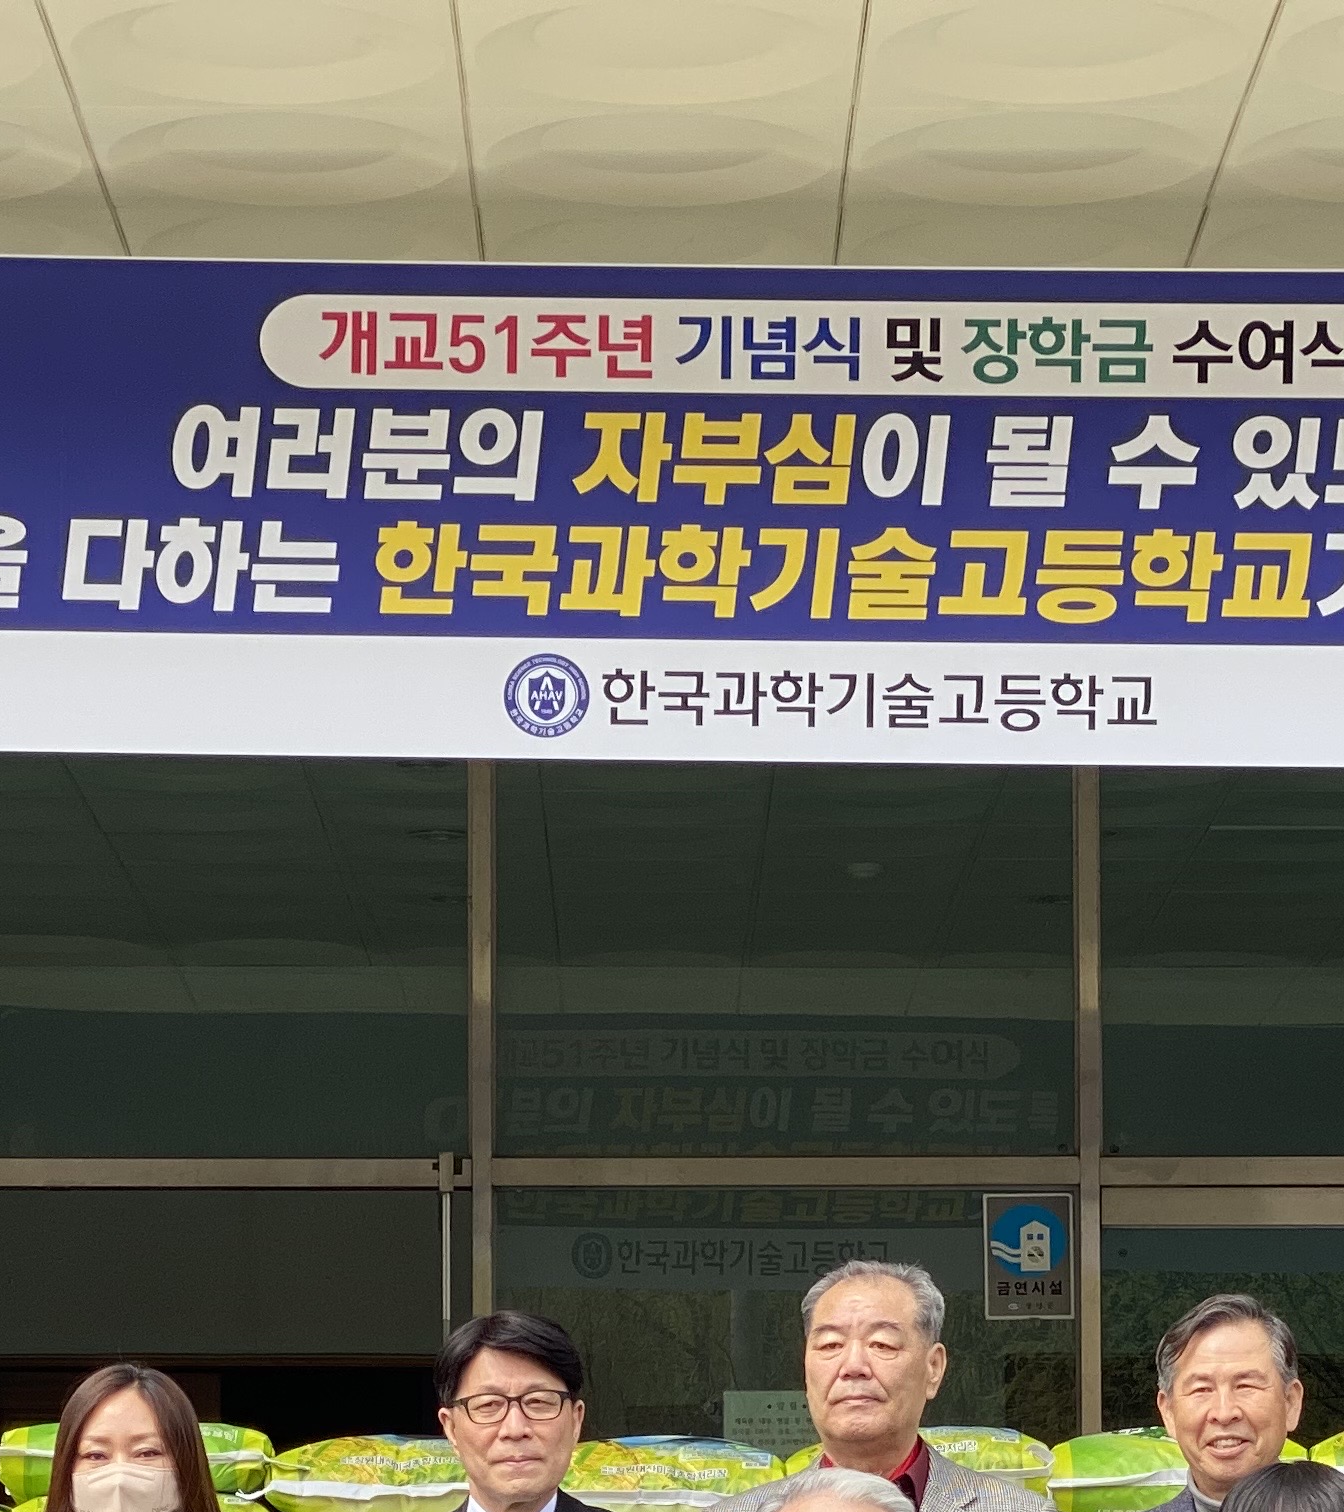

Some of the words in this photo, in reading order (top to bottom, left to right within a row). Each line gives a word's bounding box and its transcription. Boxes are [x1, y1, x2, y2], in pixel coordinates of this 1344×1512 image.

[319, 309, 653, 381] 개교51주년
[676, 315, 862, 383] 기념식
[885, 318, 941, 384] 및
[962, 317, 1153, 385] 장학금
[172, 403, 545, 501] 여러분의
[574, 411, 950, 507] 자부심이
[986, 414, 1073, 509] 될
[1108, 415, 1200, 509] 수
[61, 517, 340, 614] 다하는
[602, 667, 1158, 732] 한국과학기술고등학교
[997, 1280, 1063, 1296] 금연시설
